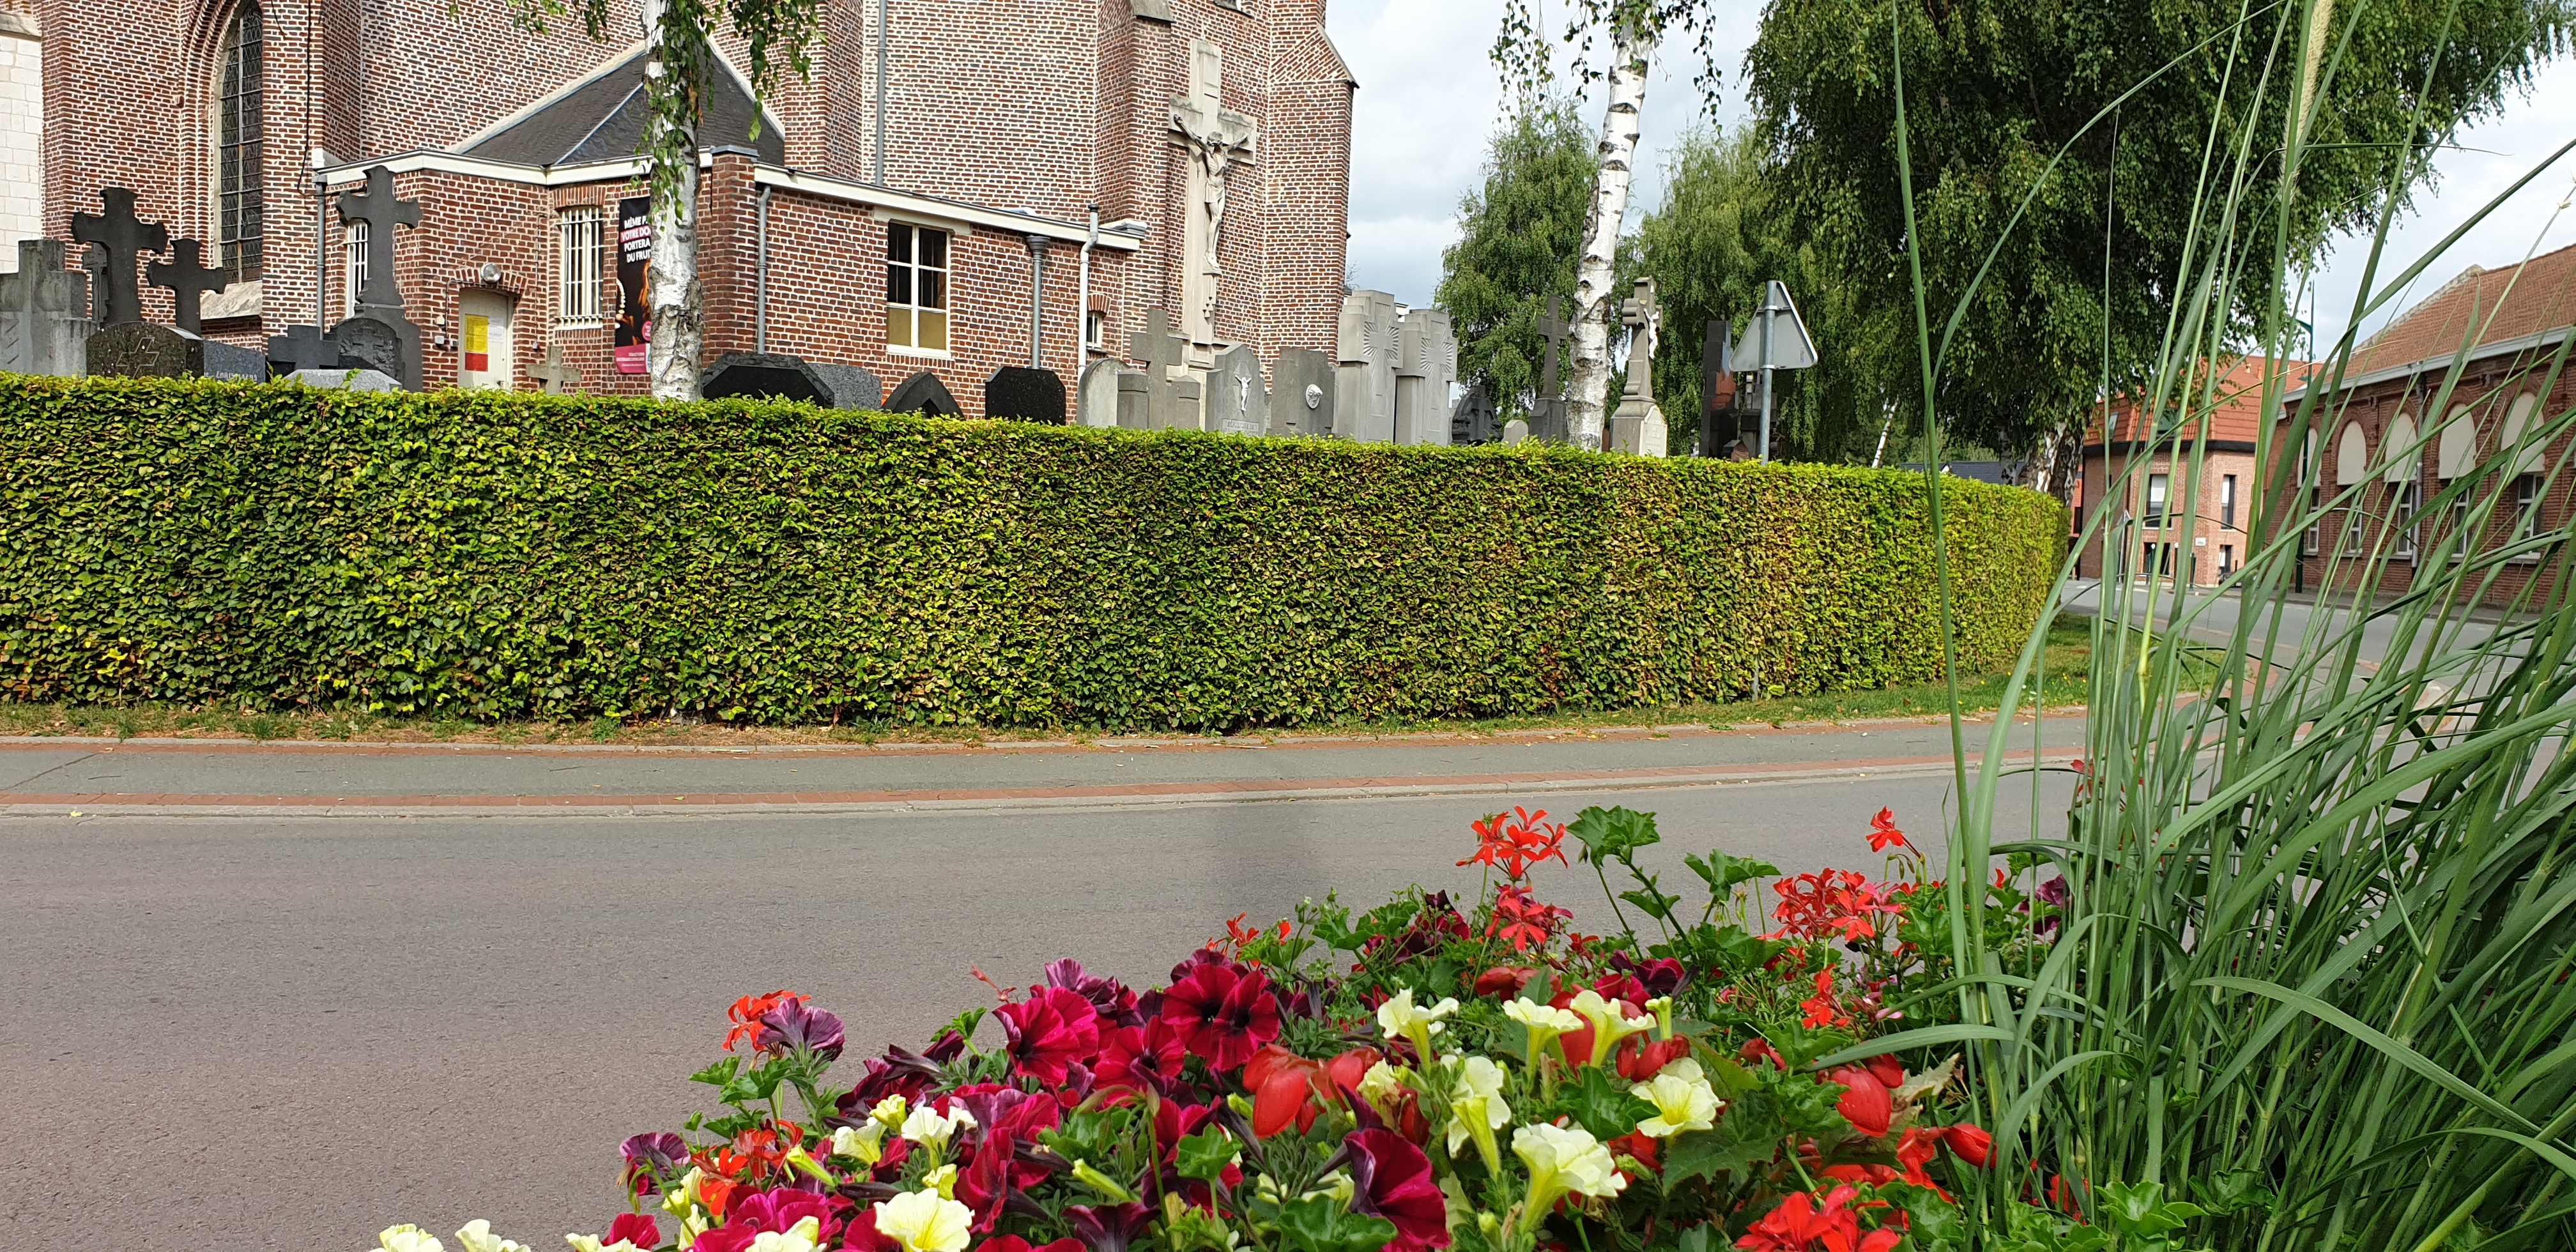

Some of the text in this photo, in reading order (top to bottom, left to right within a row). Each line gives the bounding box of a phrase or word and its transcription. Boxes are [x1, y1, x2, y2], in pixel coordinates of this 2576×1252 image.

[621, 228, 639, 241] VOTRE
[624, 238, 651, 252] PORTERA
[627, 253, 635, 263] DU
